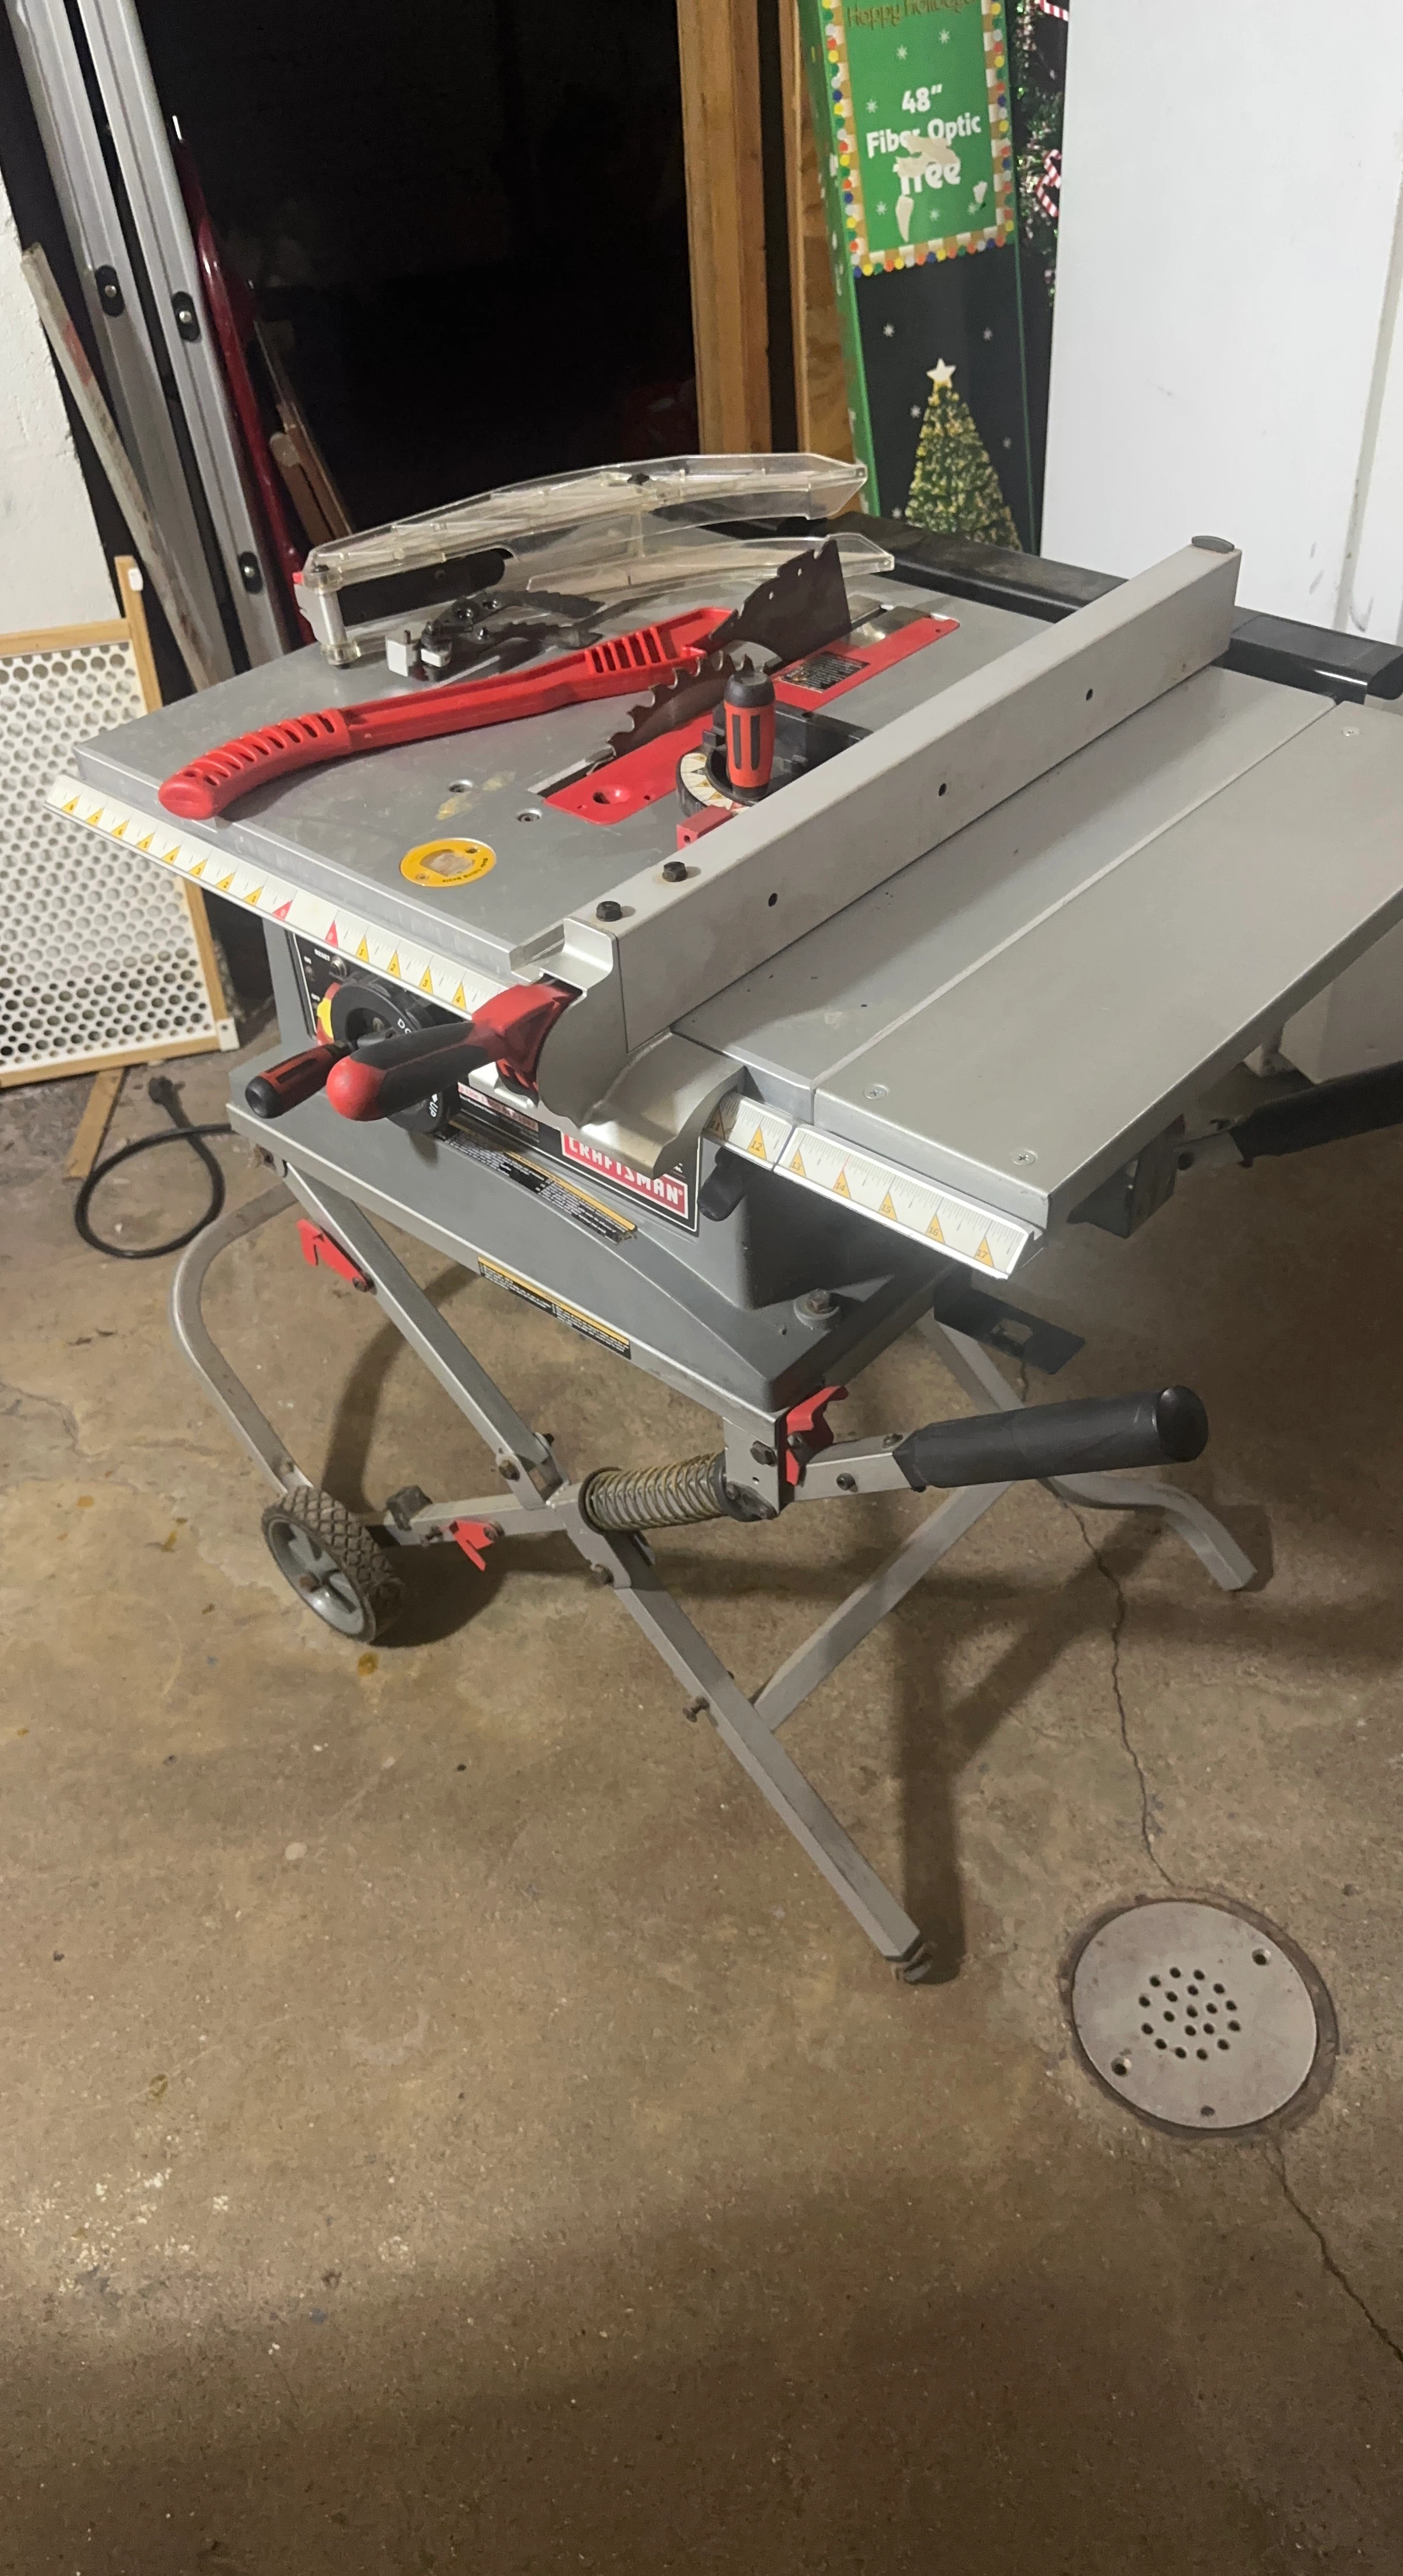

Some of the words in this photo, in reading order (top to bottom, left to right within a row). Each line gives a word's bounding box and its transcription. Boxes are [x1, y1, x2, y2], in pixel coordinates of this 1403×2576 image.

[927, 112, 982, 147] Optic
[358, 948, 365, 956] 1
[390, 963, 396, 972] 2
[422, 979, 429, 988] 3
[455, 995, 462, 1004] 4
[429, 1101, 438, 1117] UP
[750, 1140, 763, 1151] 12
[790, 1161, 802, 1171] 13
[835, 1183, 846, 1192] 14
[880, 1204, 892, 1214] 15
[928, 1226, 939, 1236] 16
[976, 1249, 989, 1259] 17
